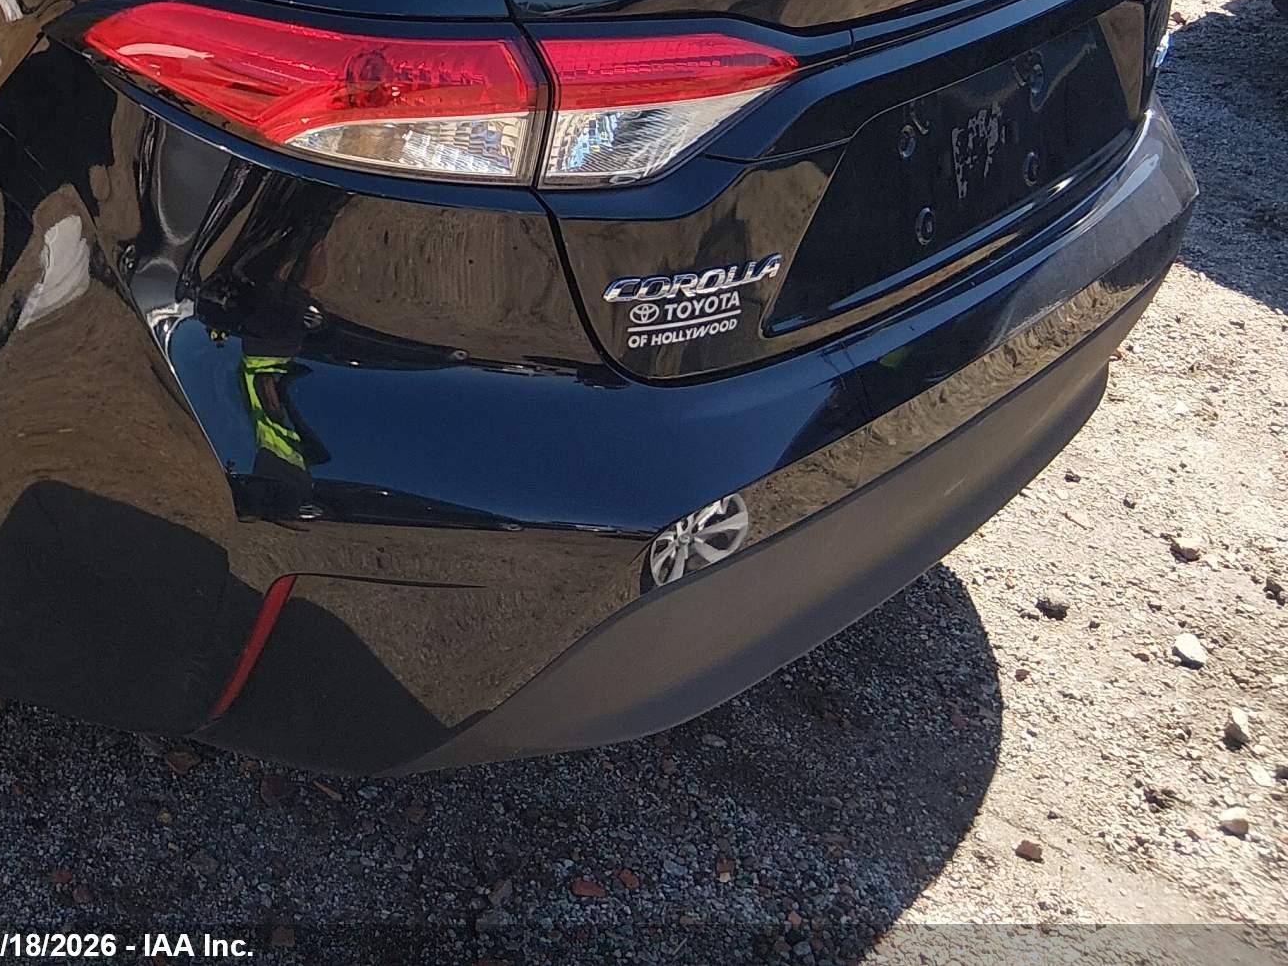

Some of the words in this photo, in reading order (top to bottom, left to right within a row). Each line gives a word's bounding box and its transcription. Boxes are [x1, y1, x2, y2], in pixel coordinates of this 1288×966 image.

[603, 252, 782, 302] COROLLA
[665, 291, 740, 321] TOYOTA
[627, 335, 647, 348] OF
[650, 318, 738, 346] HOLLYWOOD
